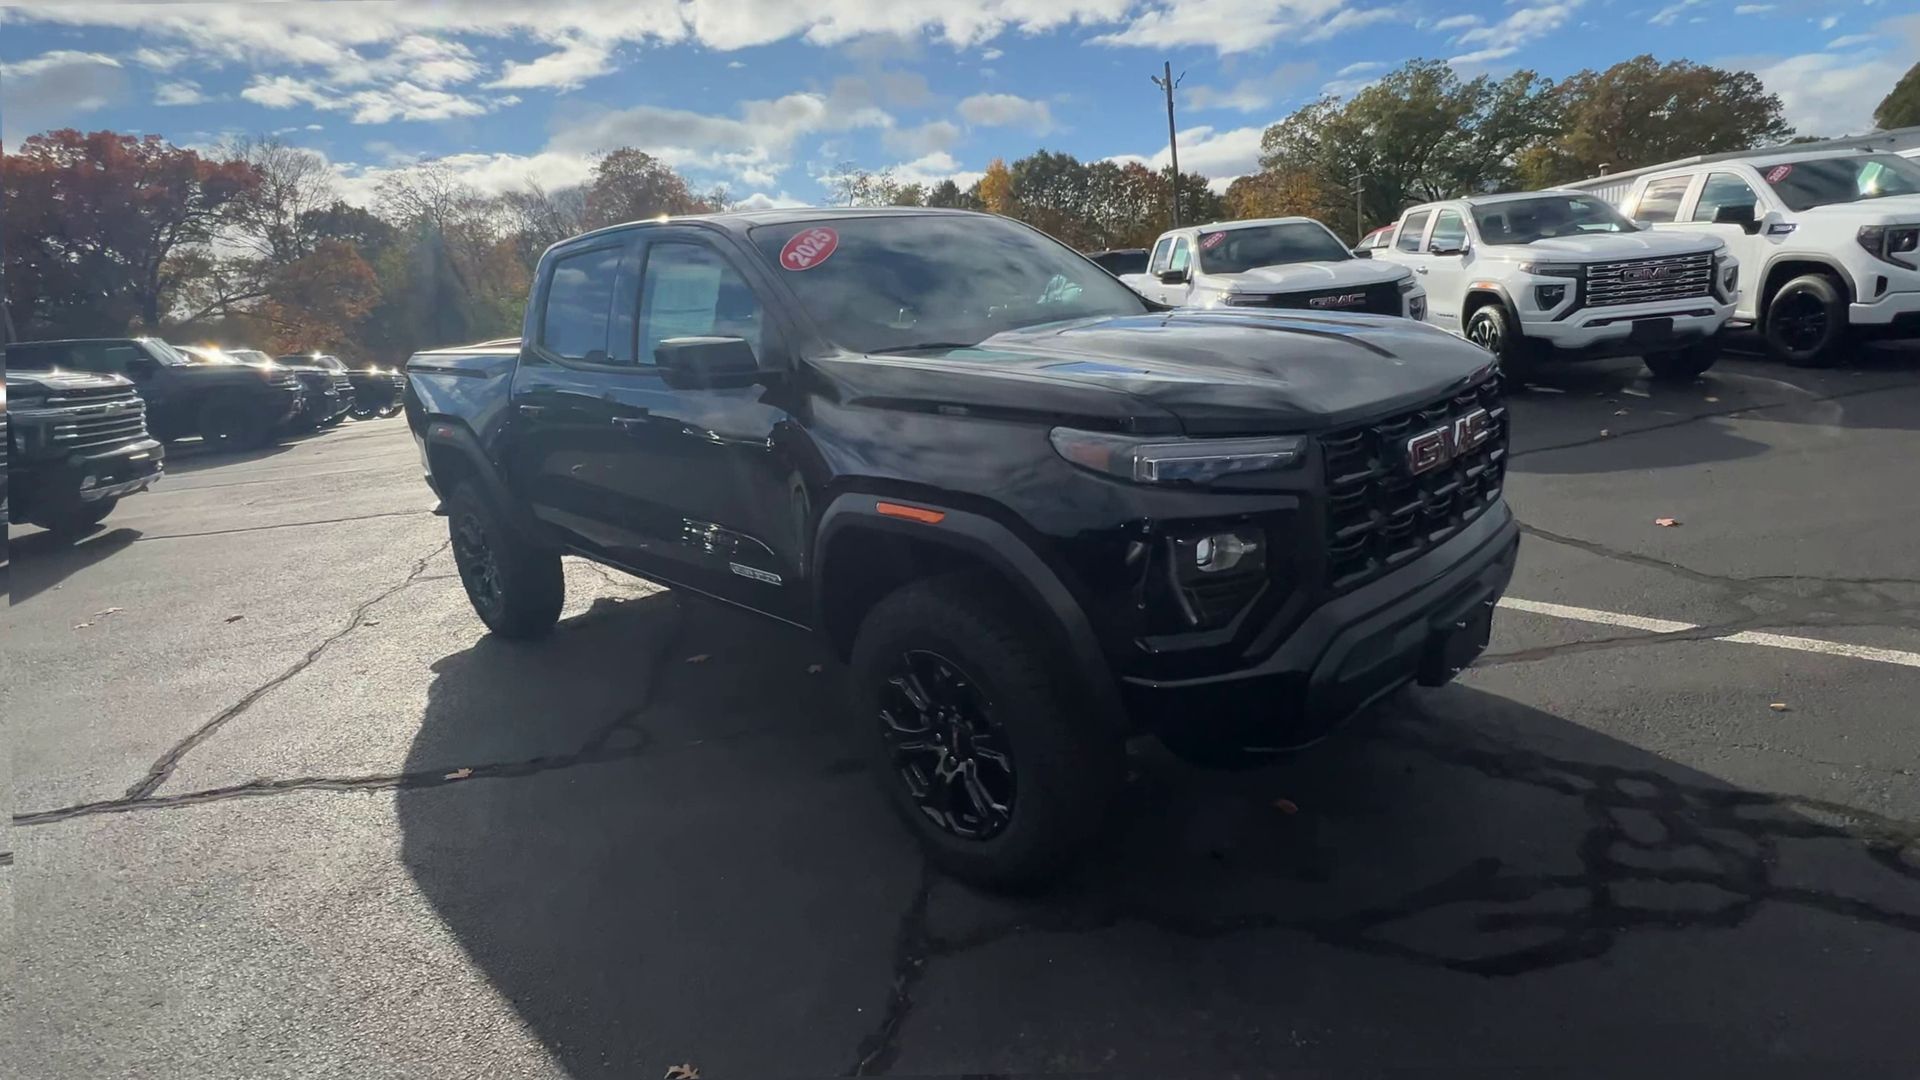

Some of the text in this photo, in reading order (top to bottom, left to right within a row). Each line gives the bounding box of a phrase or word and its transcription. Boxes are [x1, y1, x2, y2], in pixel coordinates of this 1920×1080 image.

[787, 229, 832, 267] 2025
[1623, 265, 1682, 282] GMC
[1309, 292, 1366, 307] GMC
[1408, 408, 1488, 476] GMC
